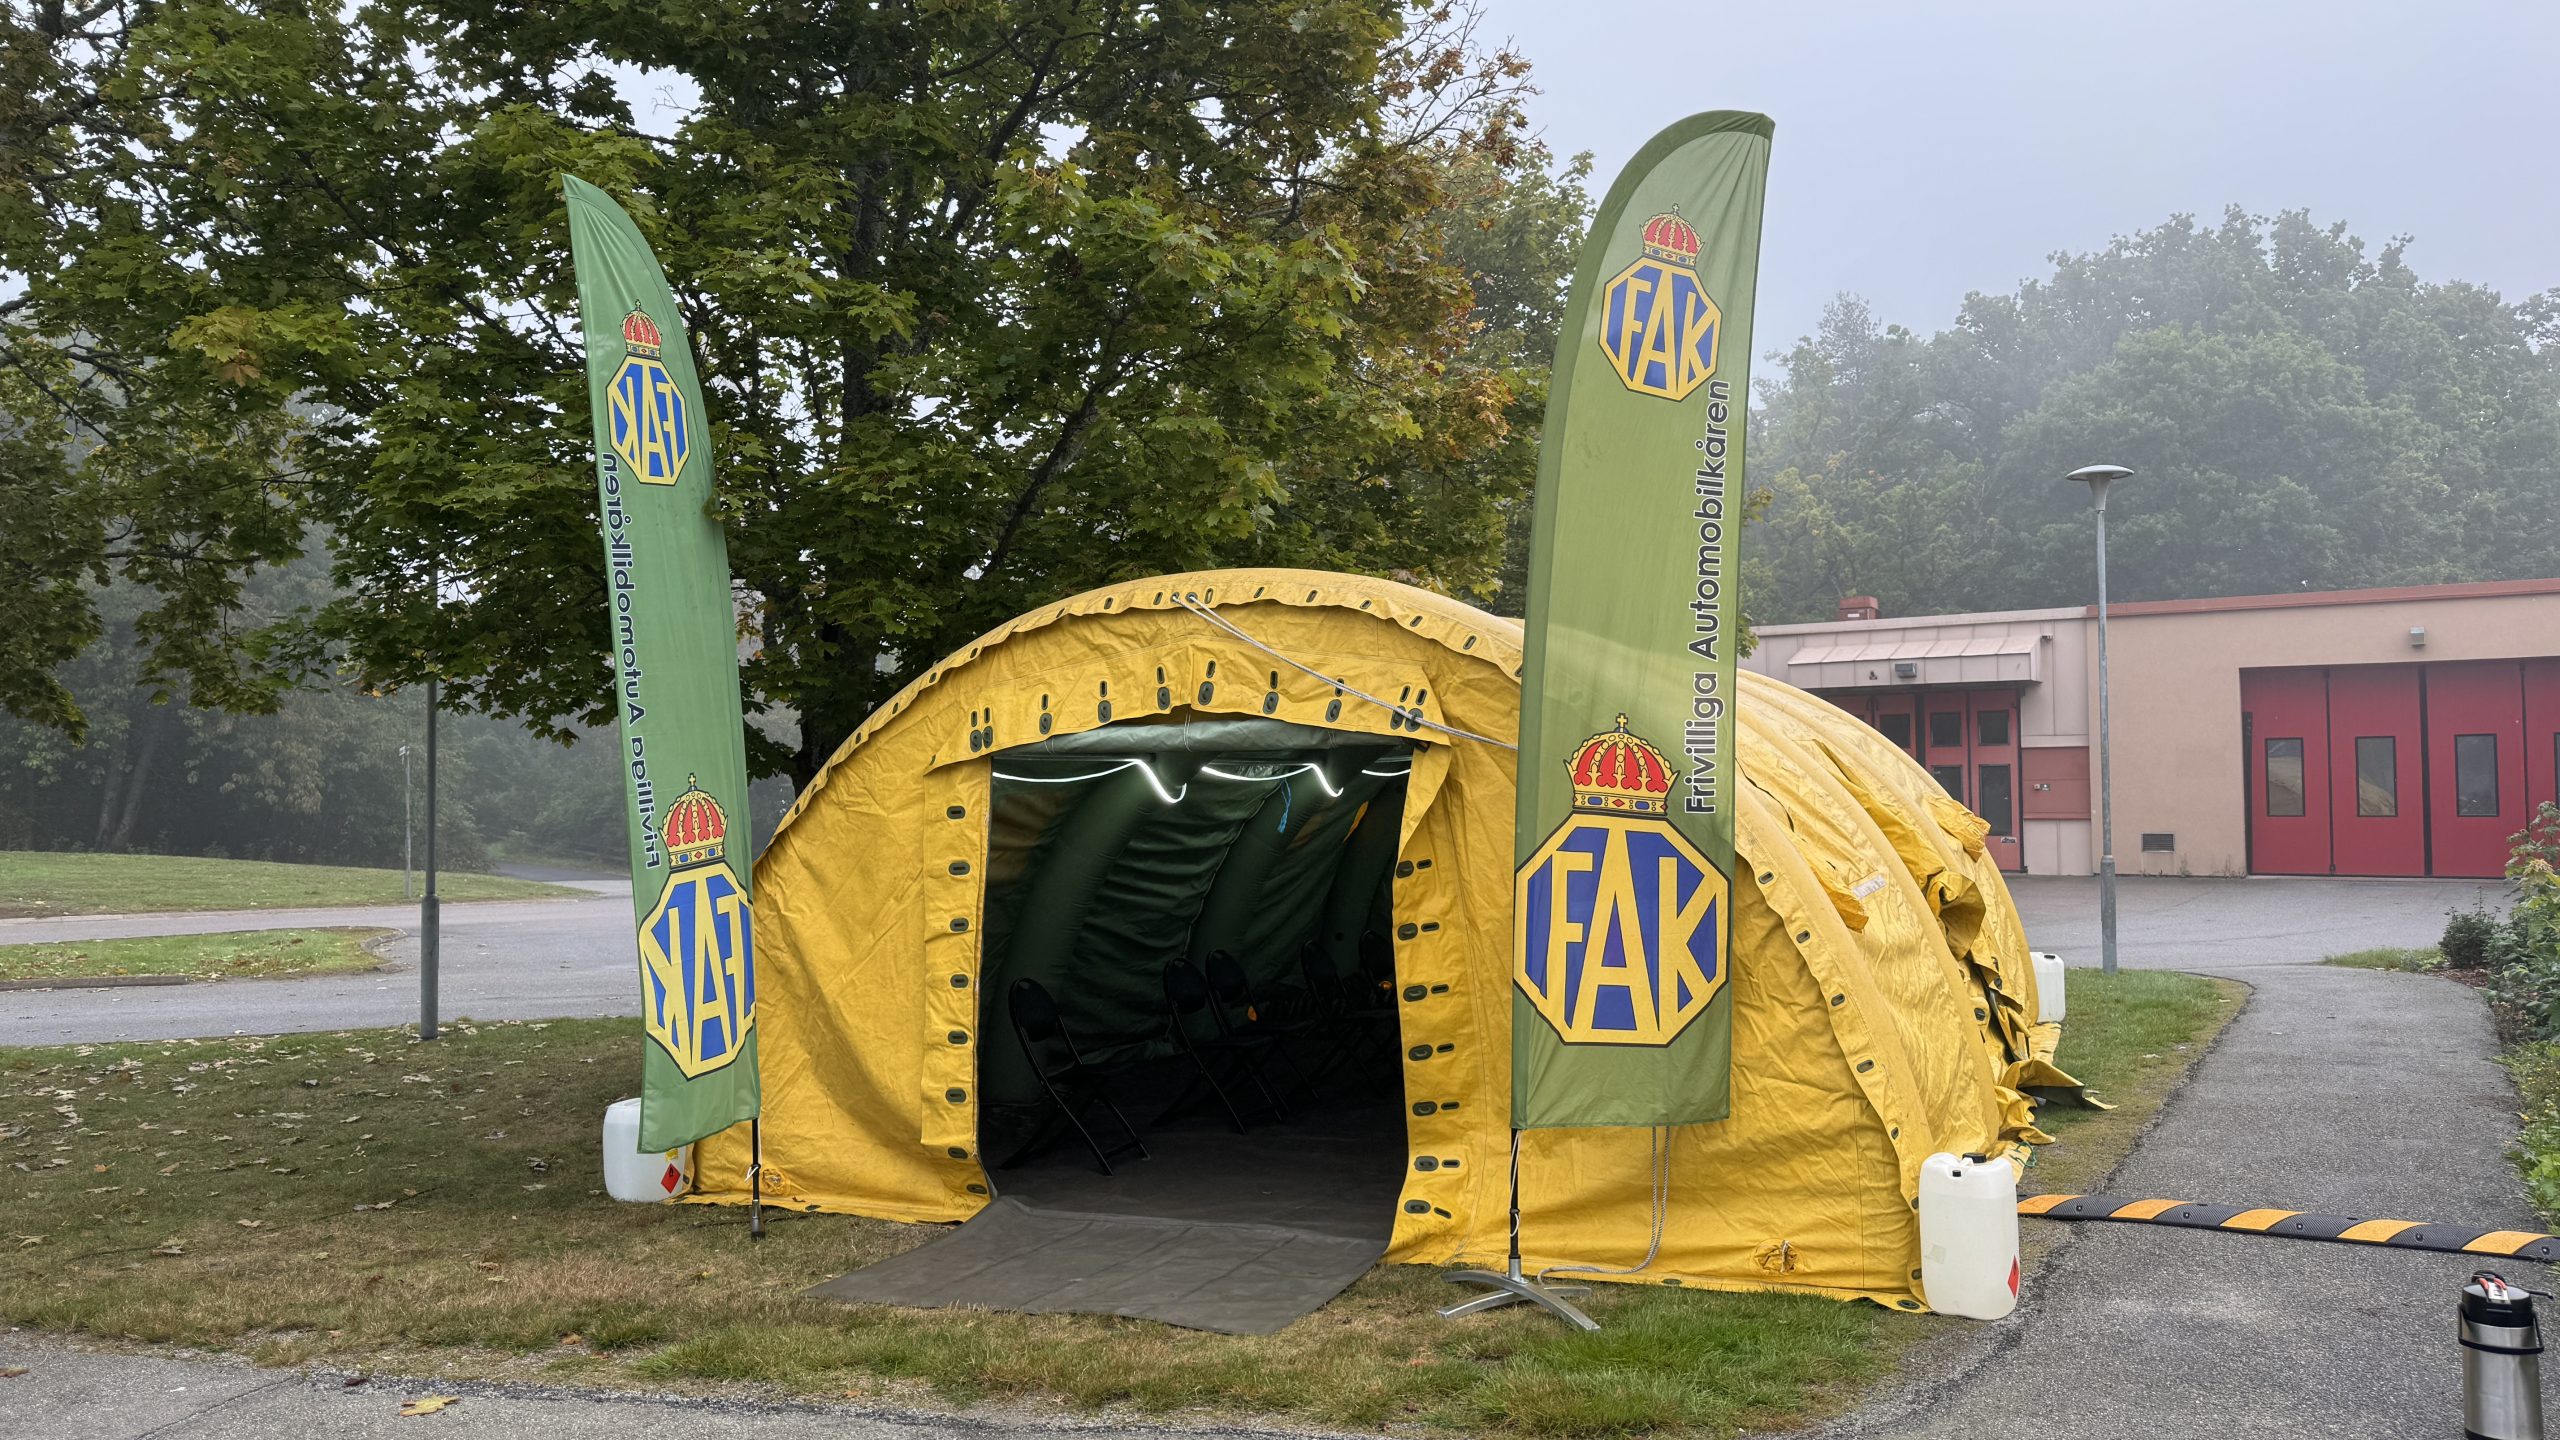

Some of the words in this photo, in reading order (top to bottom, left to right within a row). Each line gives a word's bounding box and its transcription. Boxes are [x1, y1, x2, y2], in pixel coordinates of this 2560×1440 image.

[1610, 263, 1717, 398] FAK
[1688, 379, 1729, 662] Automobilkåren
[1684, 672, 1725, 813] Frivilliga
[1535, 824, 1724, 1040] FAK
